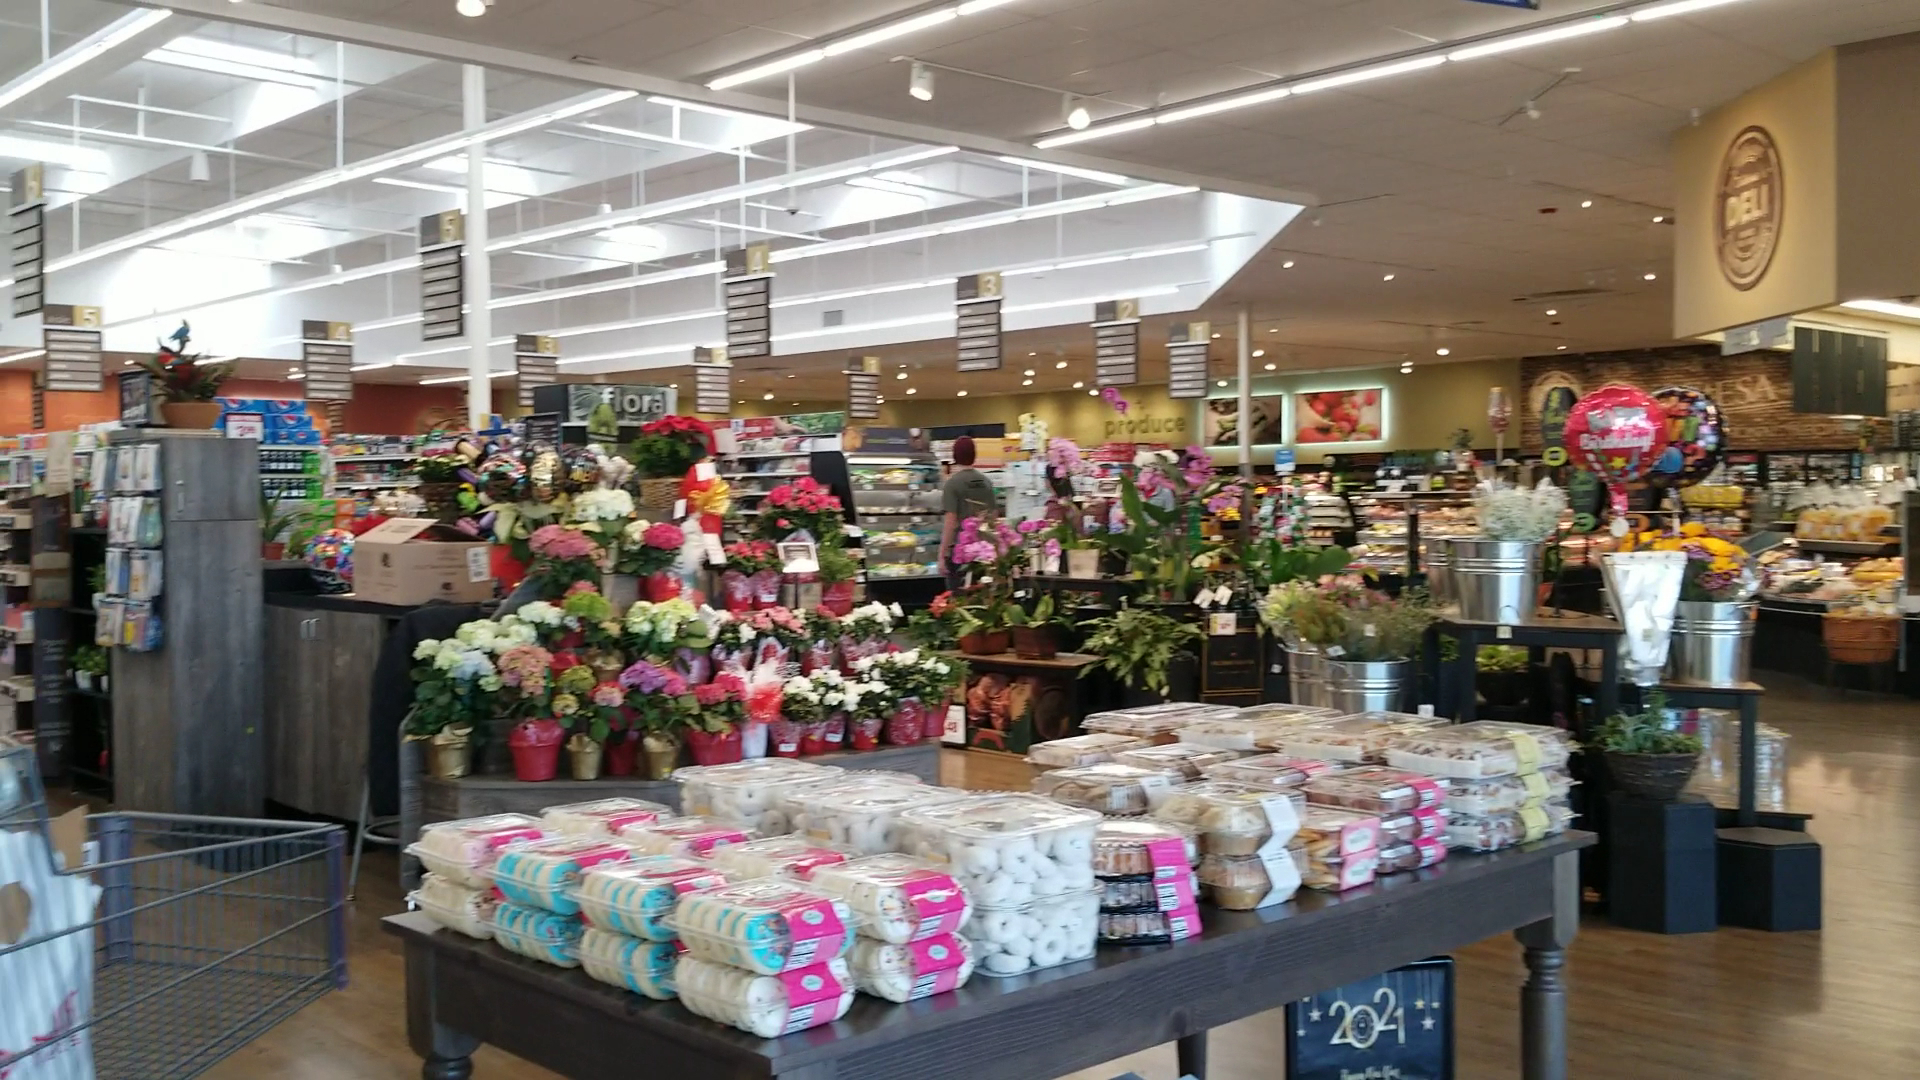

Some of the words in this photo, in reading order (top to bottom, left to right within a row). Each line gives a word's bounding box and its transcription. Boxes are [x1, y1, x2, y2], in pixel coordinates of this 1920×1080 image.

[984, 276, 996, 294] 3
[83, 309, 97, 326] 5
[1122, 302, 1134, 319] 2
[600, 387, 667, 413] flora
[1105, 415, 1186, 438] produce
[1329, 987, 1405, 1049] 2021
